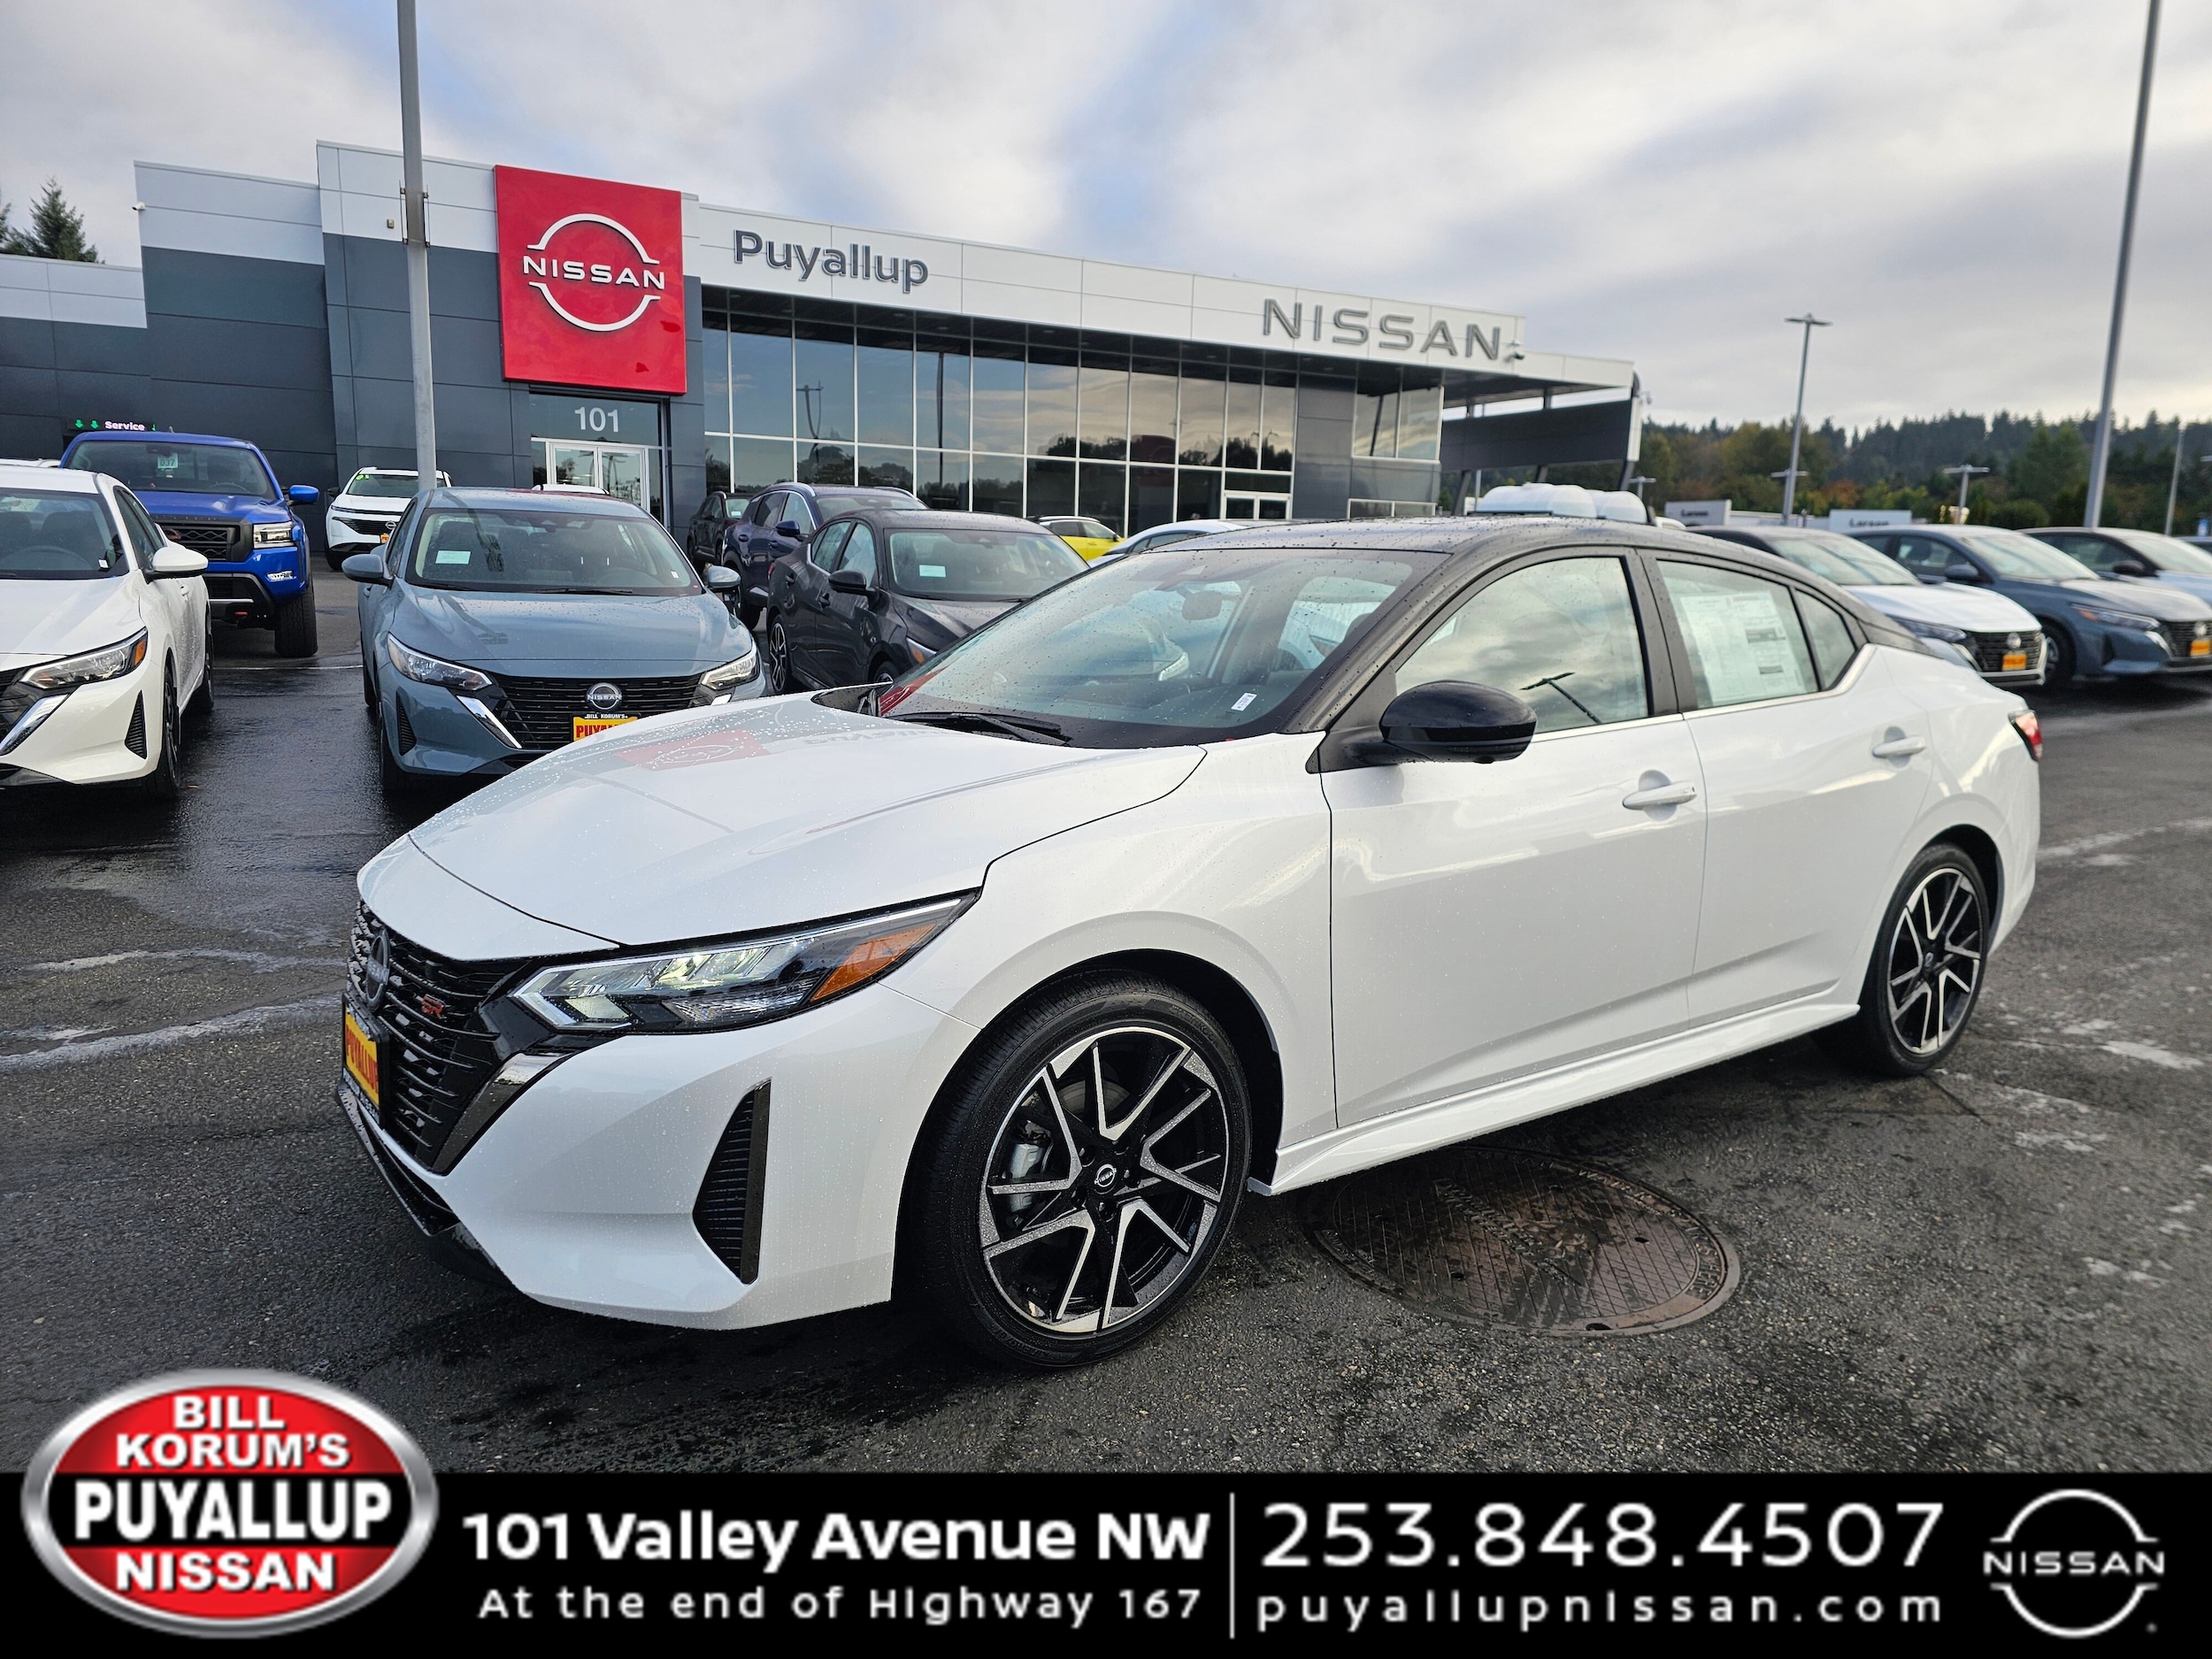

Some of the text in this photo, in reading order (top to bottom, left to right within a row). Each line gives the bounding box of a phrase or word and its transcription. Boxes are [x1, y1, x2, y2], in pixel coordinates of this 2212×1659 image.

[523, 255, 665, 290] NISSAN
[733, 228, 928, 294] Puyallup
[1263, 297, 1501, 361] NISSAN
[104, 420, 145, 431] Service
[574, 406, 619, 434] 101
